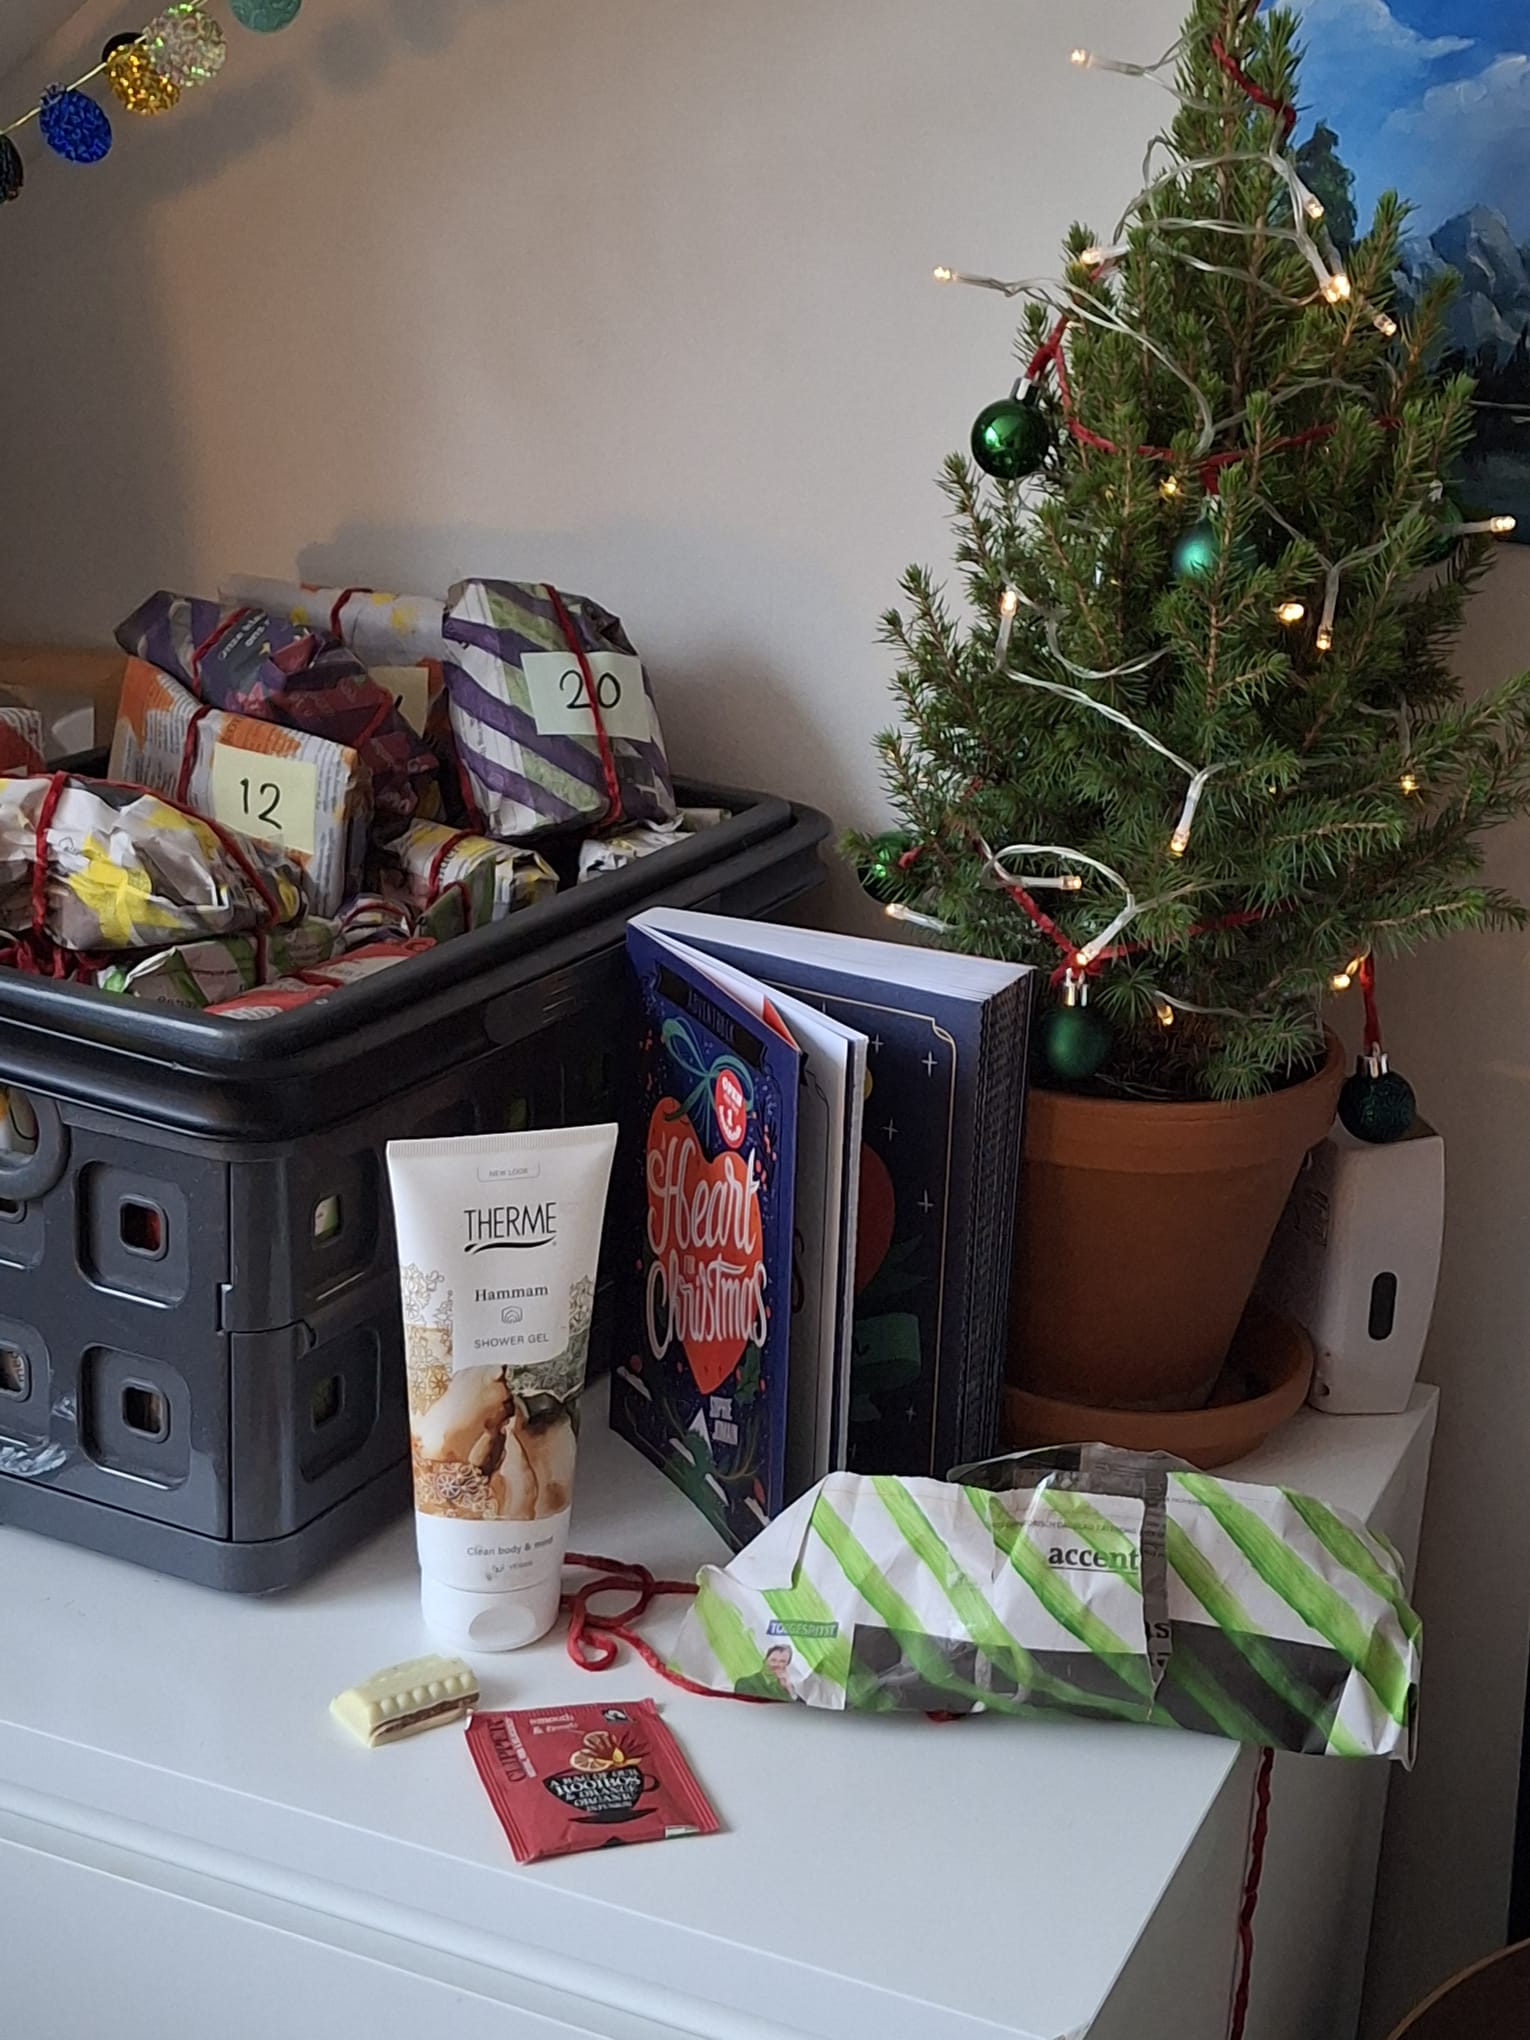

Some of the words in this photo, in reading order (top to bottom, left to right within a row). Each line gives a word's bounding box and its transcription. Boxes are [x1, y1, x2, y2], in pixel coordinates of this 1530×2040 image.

[559, 669, 621, 709] 20
[240, 778, 282, 830] 12
[647, 1134, 760, 1255] Heart
[463, 1202, 557, 1241] THERME
[474, 1285, 549, 1302] Hammam
[646, 1248, 768, 1360] Christmas
[473, 1335, 525, 1349] SHOWER
[527, 1333, 550, 1344] GEL
[466, 1545, 496, 1557] Clean
[498, 1544, 522, 1556] body
[524, 1542, 532, 1551] &
[1049, 1546, 1140, 1570] accent
